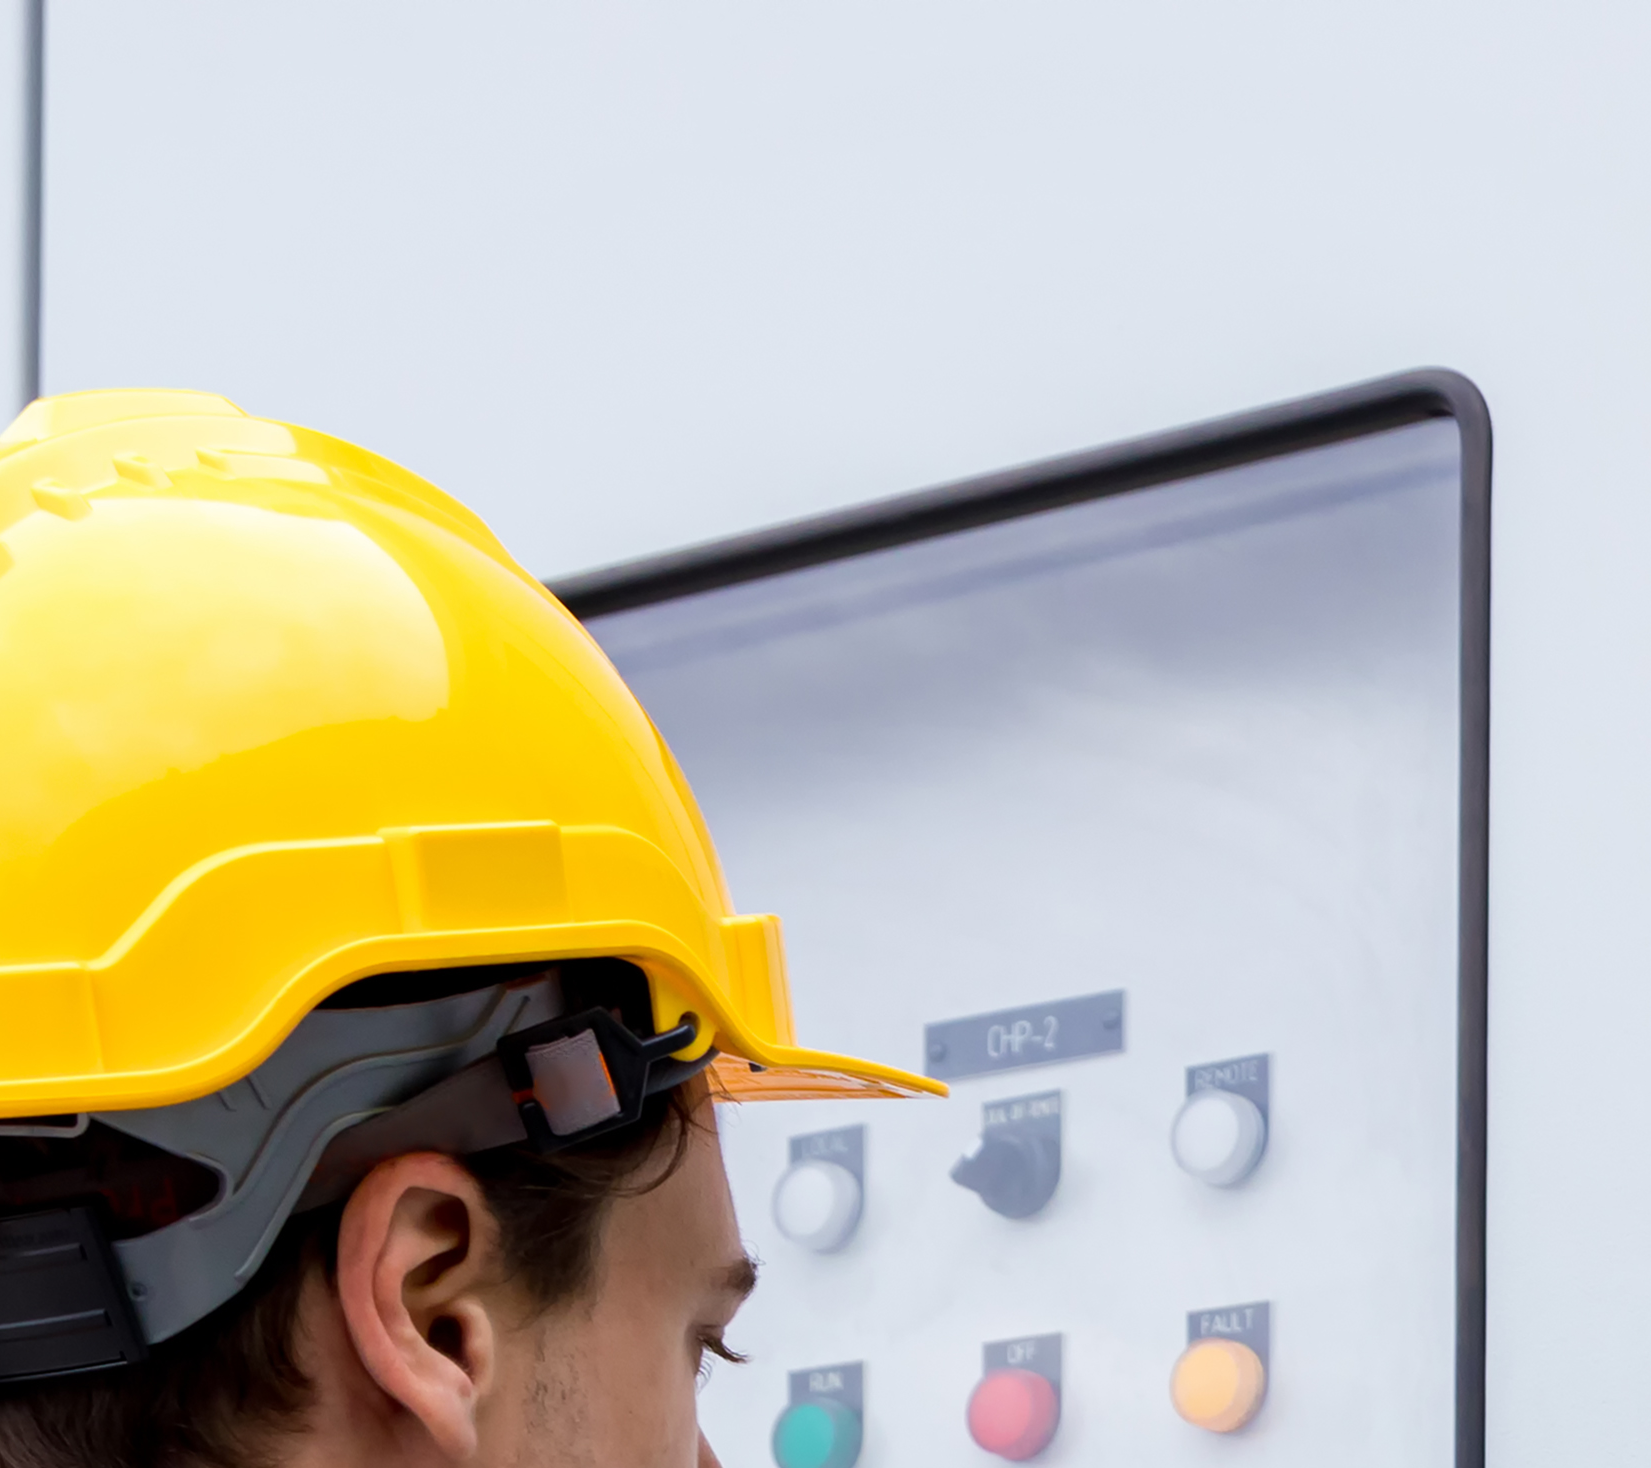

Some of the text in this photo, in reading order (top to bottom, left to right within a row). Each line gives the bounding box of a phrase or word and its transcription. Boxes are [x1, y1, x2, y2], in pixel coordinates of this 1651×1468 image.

[986, 1015, 1058, 1059] CHP-2
[1200, 1308, 1254, 1335] FAULT
[810, 1371, 843, 1392] RUN
